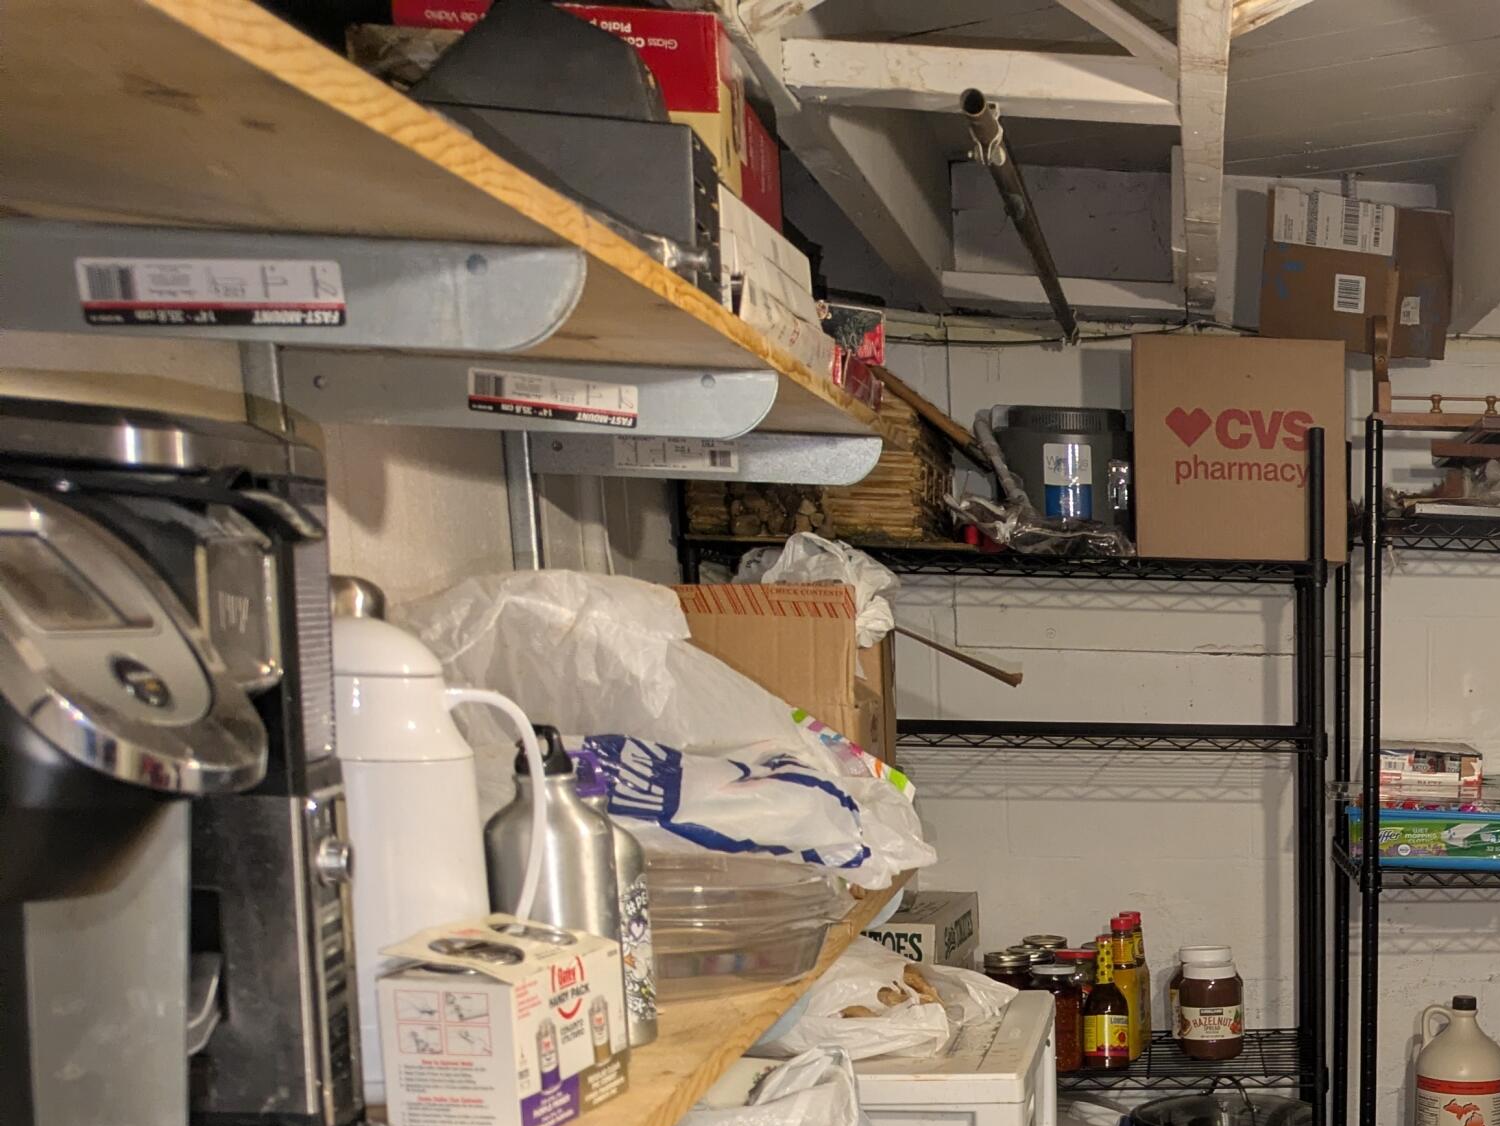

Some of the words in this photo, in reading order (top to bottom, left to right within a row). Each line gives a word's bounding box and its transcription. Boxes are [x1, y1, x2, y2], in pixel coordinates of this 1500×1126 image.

[424, 9, 457, 22] Vidrio
[600, 21, 632, 33] Plato
[647, 38, 678, 49] Glass
[252, 309, 340, 324] FAST-MOUNT
[576, 412, 633, 427] FAST-MOUNT
[1215, 408, 1314, 451] CVS
[1175, 454, 1309, 488] pharmacy
[1192, 1016, 1233, 1027] HAZELNUT
